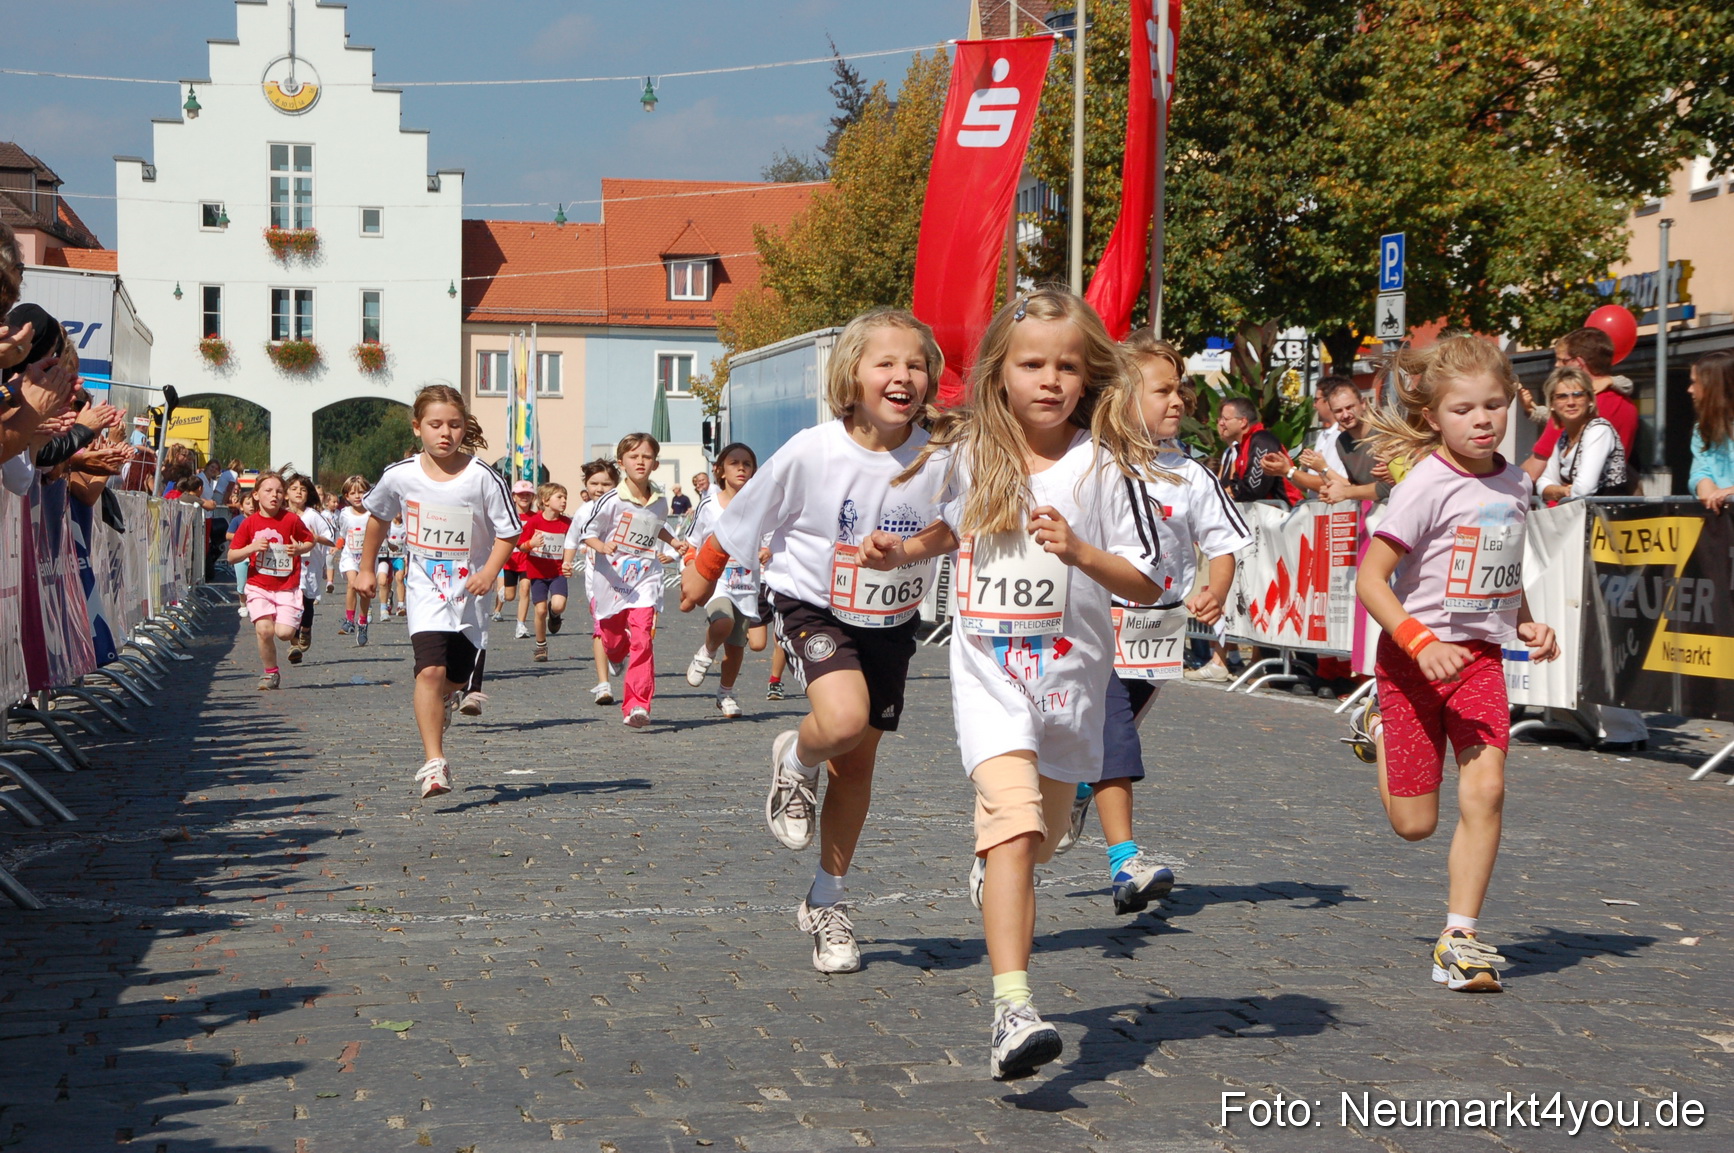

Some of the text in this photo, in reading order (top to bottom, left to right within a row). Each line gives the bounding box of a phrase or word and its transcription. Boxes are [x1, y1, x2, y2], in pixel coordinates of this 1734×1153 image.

[1384, 241, 1400, 284] P
[168, 415, 205, 431] Glossner
[423, 527, 466, 546] 7174
[629, 531, 655, 547] 7226
[1483, 534, 1503, 551] Lea
[265, 557, 290, 568] 7153
[1481, 562, 1521, 589] 7089
[864, 576, 924, 607] 7063
[976, 576, 1055, 608] 7182
[1014, 618, 1062, 630] PFLEIDERER
[1126, 615, 1162, 630] Melina
[1125, 637, 1178, 660] 7077
